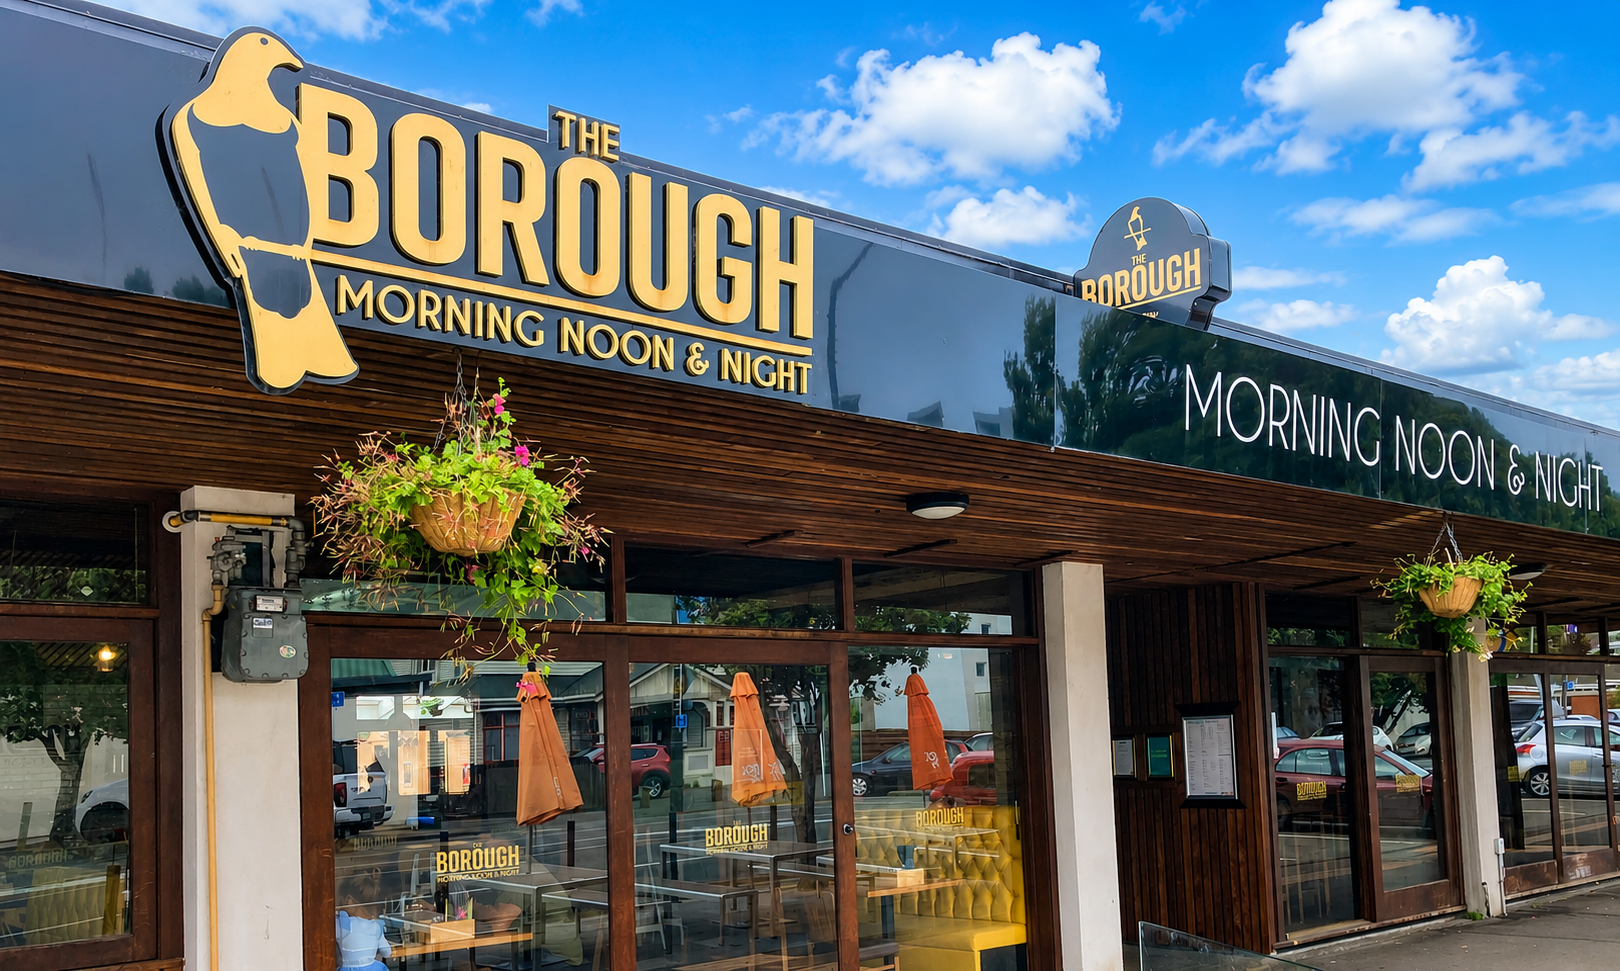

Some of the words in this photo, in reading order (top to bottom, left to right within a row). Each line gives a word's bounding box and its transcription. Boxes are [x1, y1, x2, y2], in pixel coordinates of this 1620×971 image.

[552, 110, 620, 162] THE
[297, 83, 814, 340] BOROUGH
[1081, 247, 1201, 308] BOROUGH
[1131, 253, 1147, 266] THE
[336, 274, 545, 348] MORNING
[559, 319, 675, 371] NOON
[686, 342, 710, 376] &
[720, 347, 813, 394] NIGHT
[1184, 363, 1381, 467] MORNING
[1395, 414, 1496, 491] NOON
[1507, 443, 1525, 496] &
[1535, 451, 1604, 512] NIGHT
[705, 823, 768, 847] BOROUGH
[915, 806, 964, 828] BOROUGH
[436, 844, 520, 873] BOROUGH
